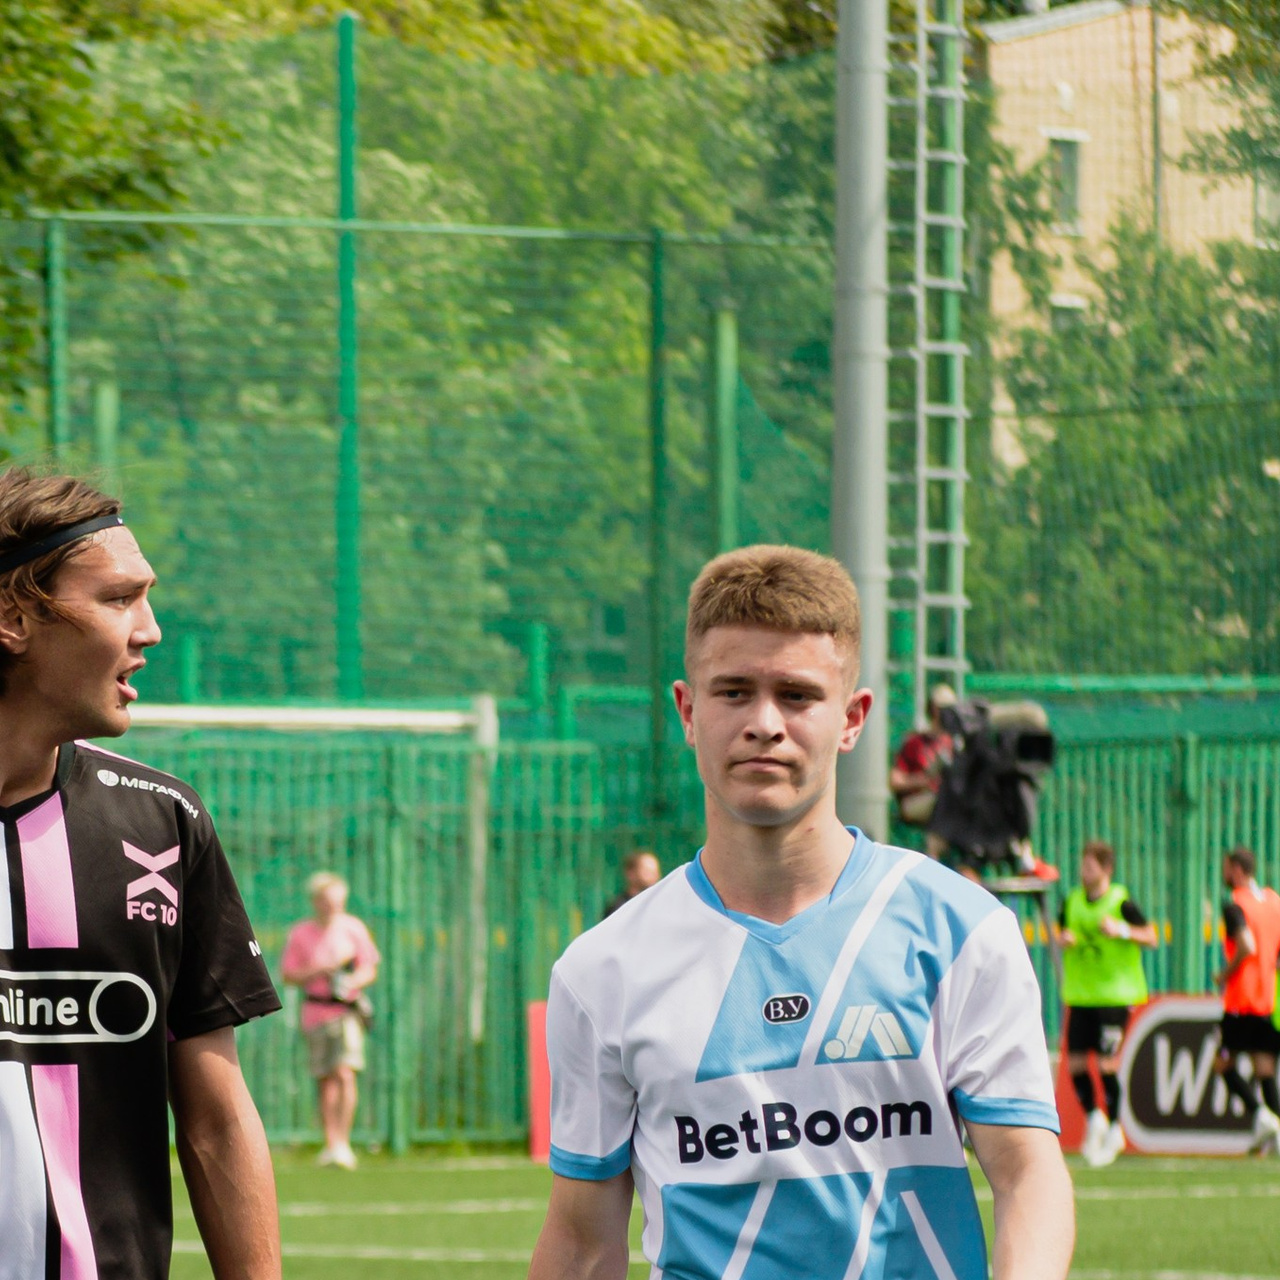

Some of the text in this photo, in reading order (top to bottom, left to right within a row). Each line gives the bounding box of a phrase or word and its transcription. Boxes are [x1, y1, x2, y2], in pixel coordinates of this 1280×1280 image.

[120, 775, 199, 819] МЕГАФОН
[126, 901, 178, 927] FC 10
[673, 1100, 933, 1164] BetBoom
